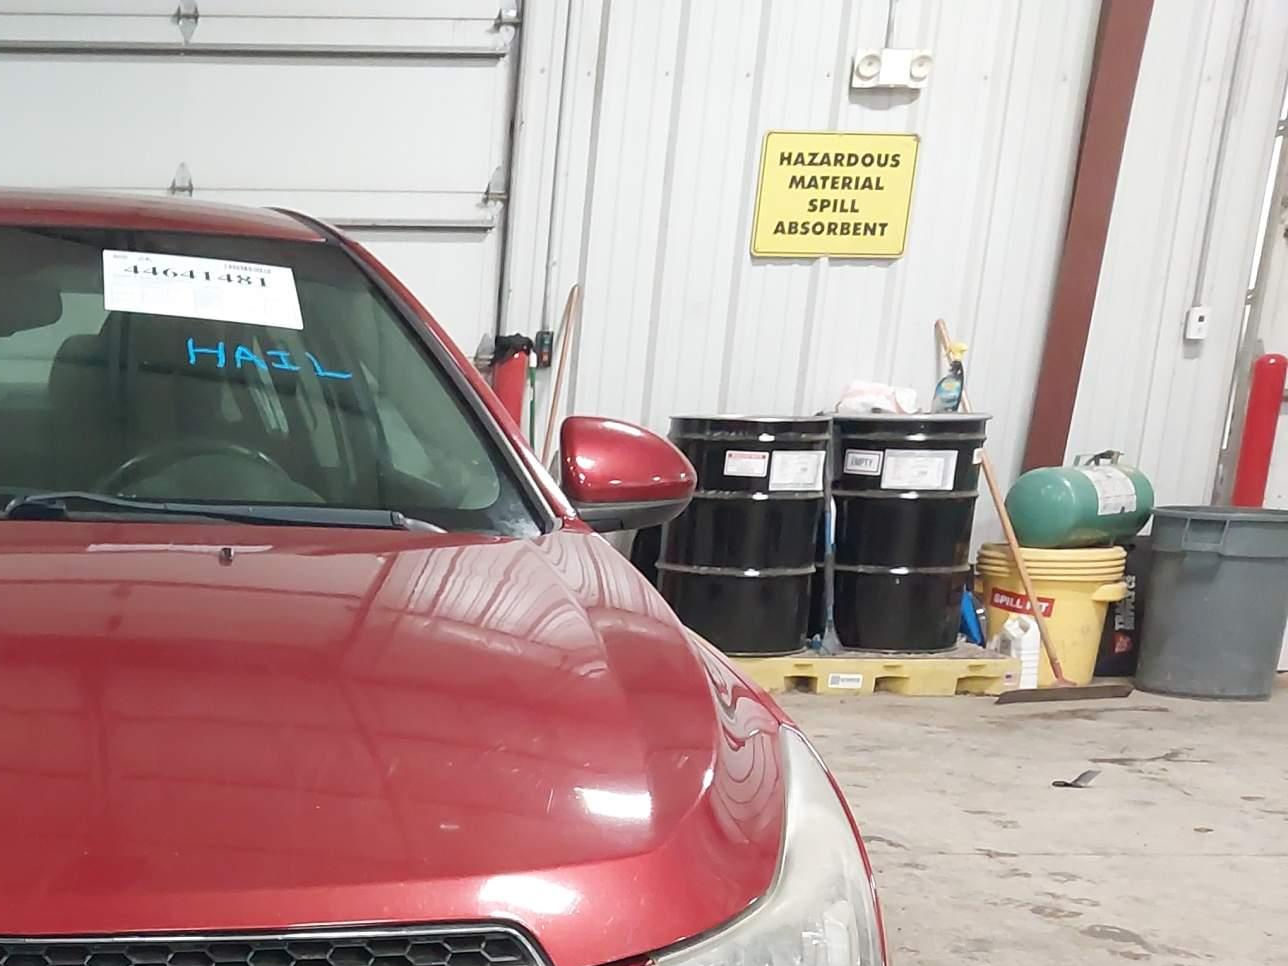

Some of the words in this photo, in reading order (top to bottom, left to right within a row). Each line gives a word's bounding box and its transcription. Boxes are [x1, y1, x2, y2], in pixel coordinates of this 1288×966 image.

[779, 152, 901, 168] HAZARDOUS
[788, 175, 884, 190] MATERIAL
[807, 198, 859, 213] SPILL
[773, 221, 888, 236] ABSORBENT
[124, 264, 269, 288] 44641481
[186, 337, 353, 380] HAIL
[993, 592, 1023, 609] SPILL
